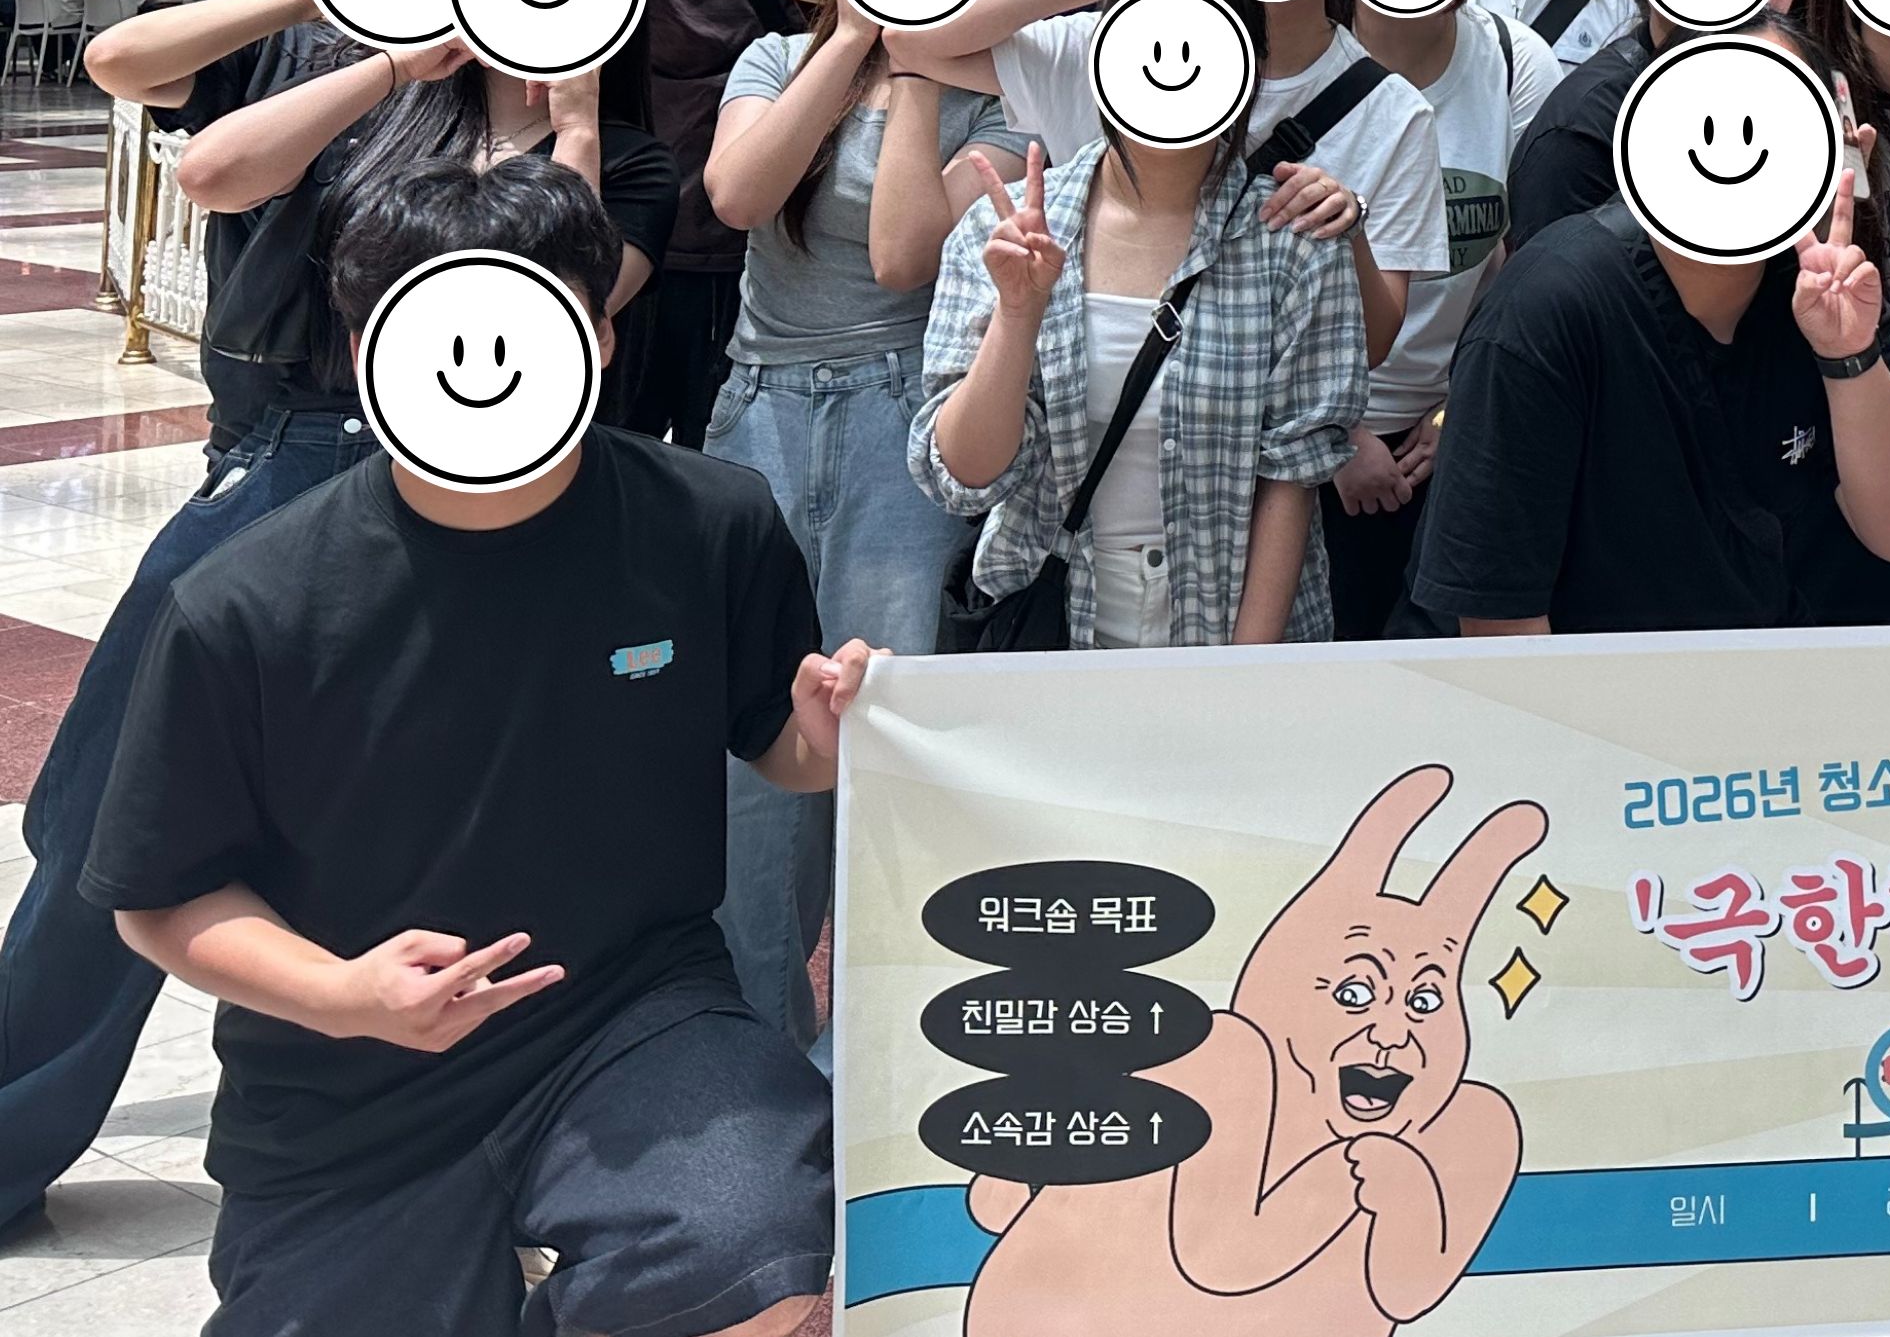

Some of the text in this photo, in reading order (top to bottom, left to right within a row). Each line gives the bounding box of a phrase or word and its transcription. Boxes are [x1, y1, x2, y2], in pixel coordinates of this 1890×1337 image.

[1443, 175, 1467, 195] AD
[1446, 201, 1500, 236] RMINAL
[626, 648, 661, 669] Lee
[1624, 766, 1801, 829] 2026년
[978, 895, 1158, 934] 워크숍 목표
[961, 999, 1132, 1035] 친밀감 상승
[960, 1110, 1131, 1147] 소속감 상승
[1669, 1194, 1725, 1227] 일시
